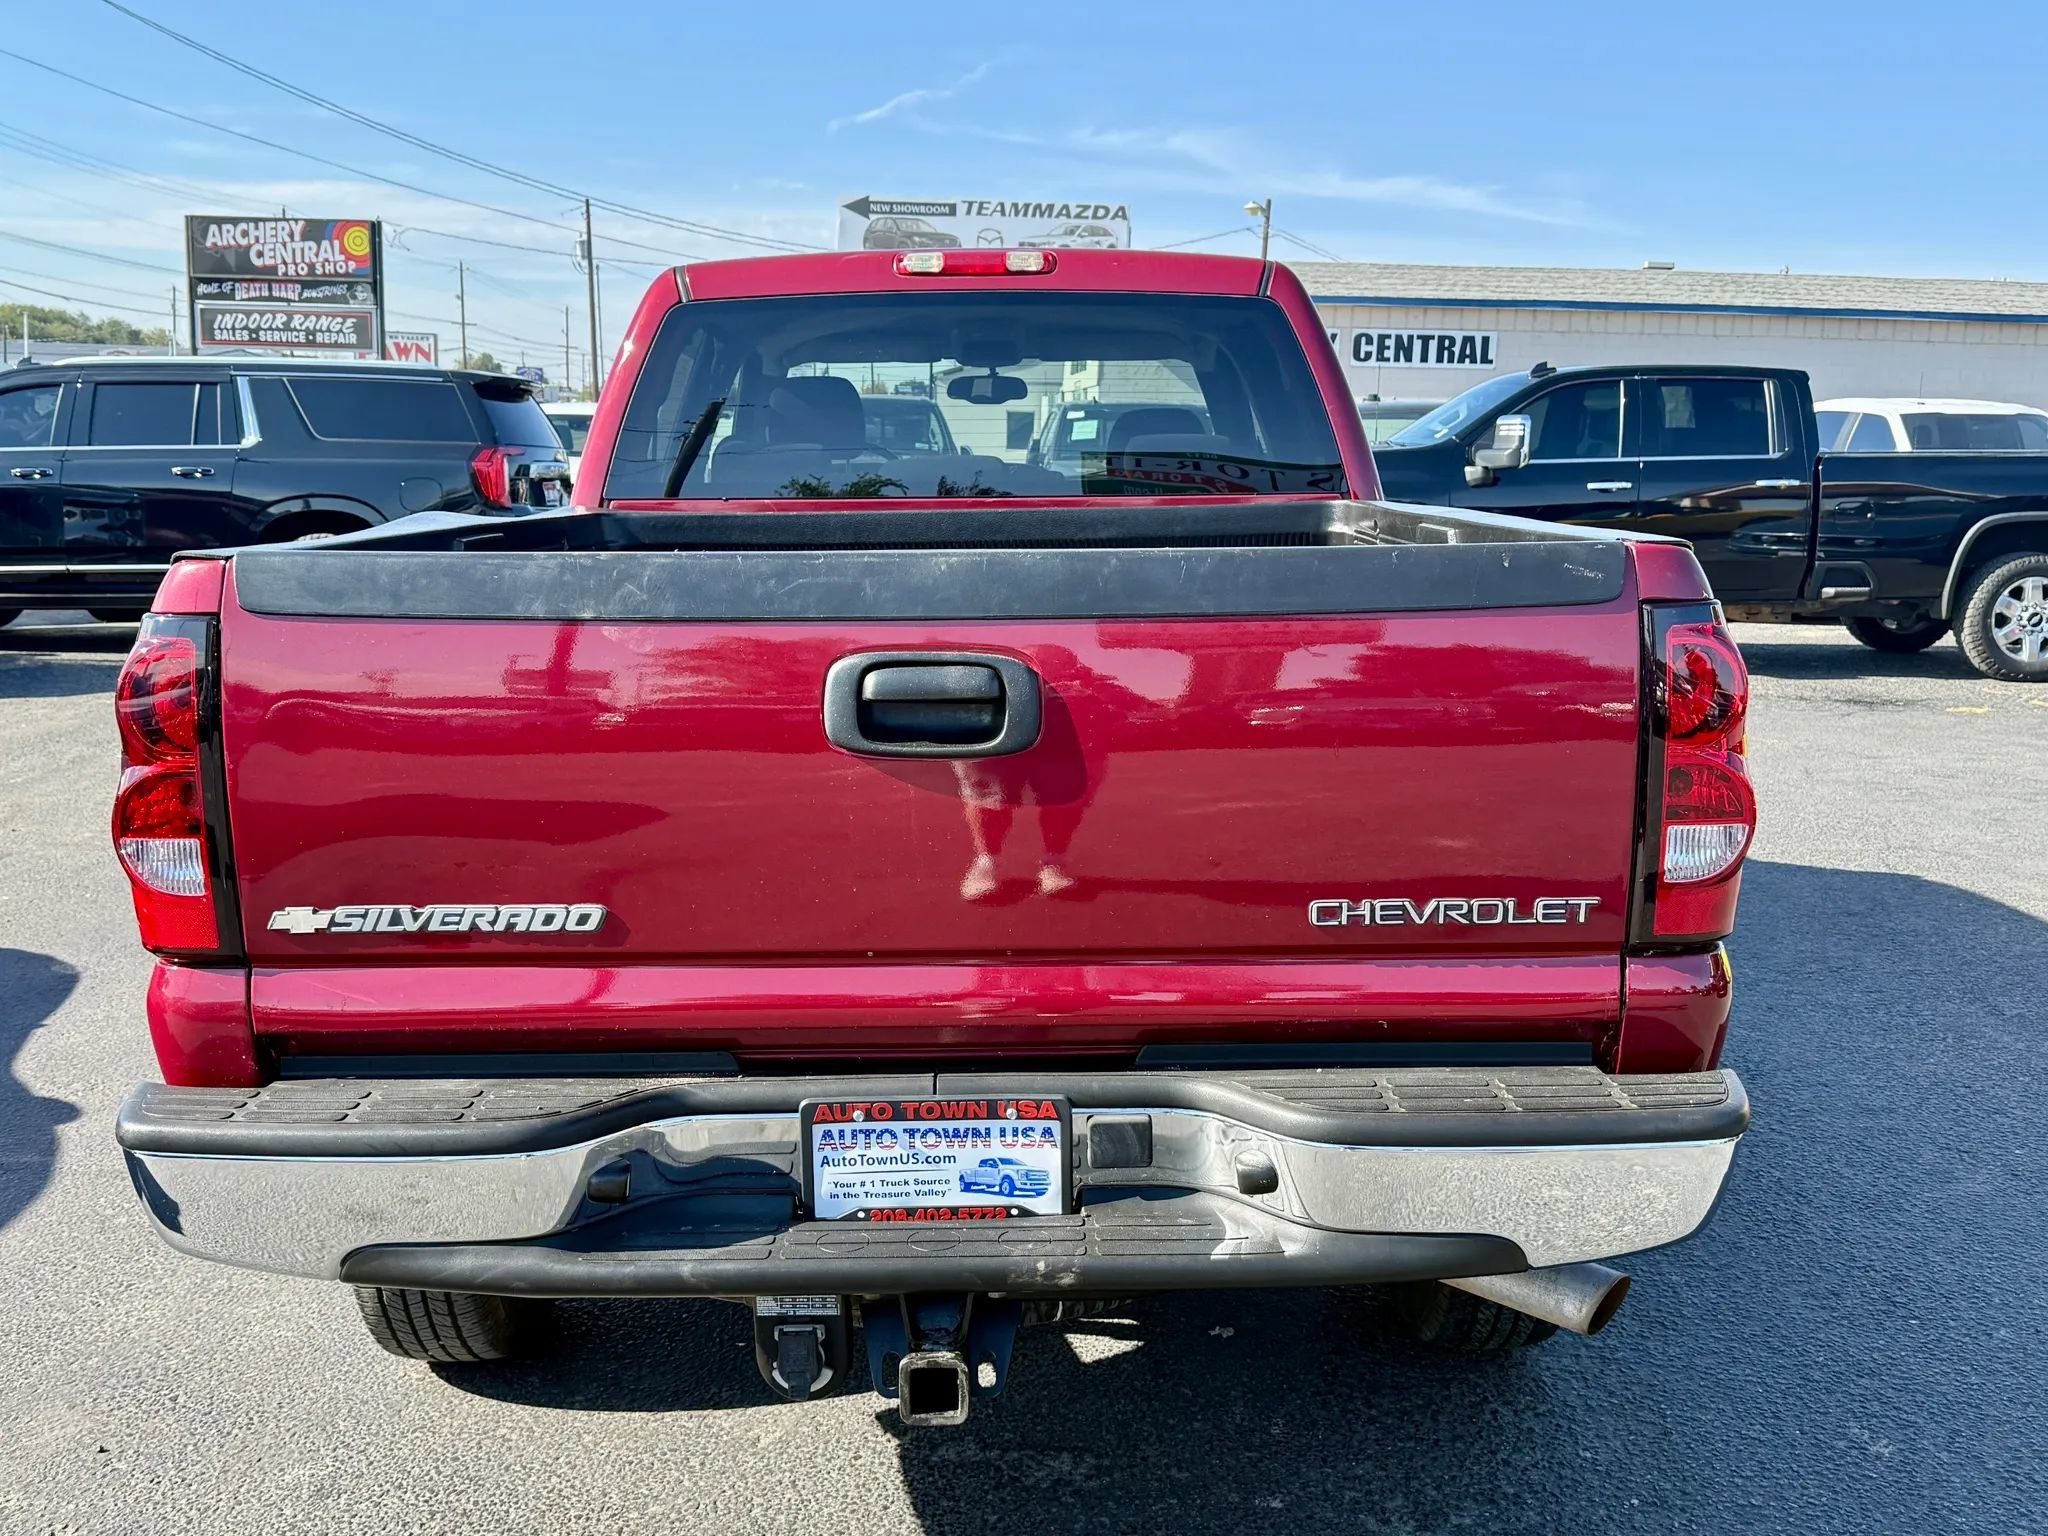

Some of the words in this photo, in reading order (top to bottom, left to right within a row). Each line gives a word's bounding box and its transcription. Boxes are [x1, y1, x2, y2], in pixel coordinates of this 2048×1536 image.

[870, 202, 890, 213] NEW
[892, 203, 949, 215] SHOWROOM
[205, 220, 305, 248] ARCHERY
[249, 240, 345, 267] CENTRAL
[278, 263, 308, 276] PRO
[315, 261, 356, 275] SHOP
[197, 282, 221, 296] HOME
[222, 281, 234, 294] OF
[234, 280, 269, 300] DEATH
[213, 312, 285, 329] INDOOR
[290, 315, 357, 333] RANGE
[214, 330, 249, 341] SALES
[259, 330, 306, 343] SERVICE
[316, 332, 357, 344] REPAIR
[1352, 332, 1494, 364] CENTRAL
[329, 904, 609, 933] SILVERADO
[1309, 897, 1601, 926] CHEVROLET
[813, 1103, 893, 1122] AUTO
[900, 1101, 989, 1120] TOWN
[997, 1100, 1058, 1120] USA
[817, 1128, 898, 1151] AUTO
[902, 1126, 991, 1149] TOWN
[999, 1126, 1058, 1149] USA
[820, 1153, 957, 1168] AutoTownUS.com
[860, 1180, 866, 1188] #
[870, 1180, 875, 1188] 1
[879, 1179, 910, 1187] Truck
[913, 1178, 951, 1186] Source
[843, 1191, 860, 1199] the
[863, 1191, 911, 1199] Treasure
